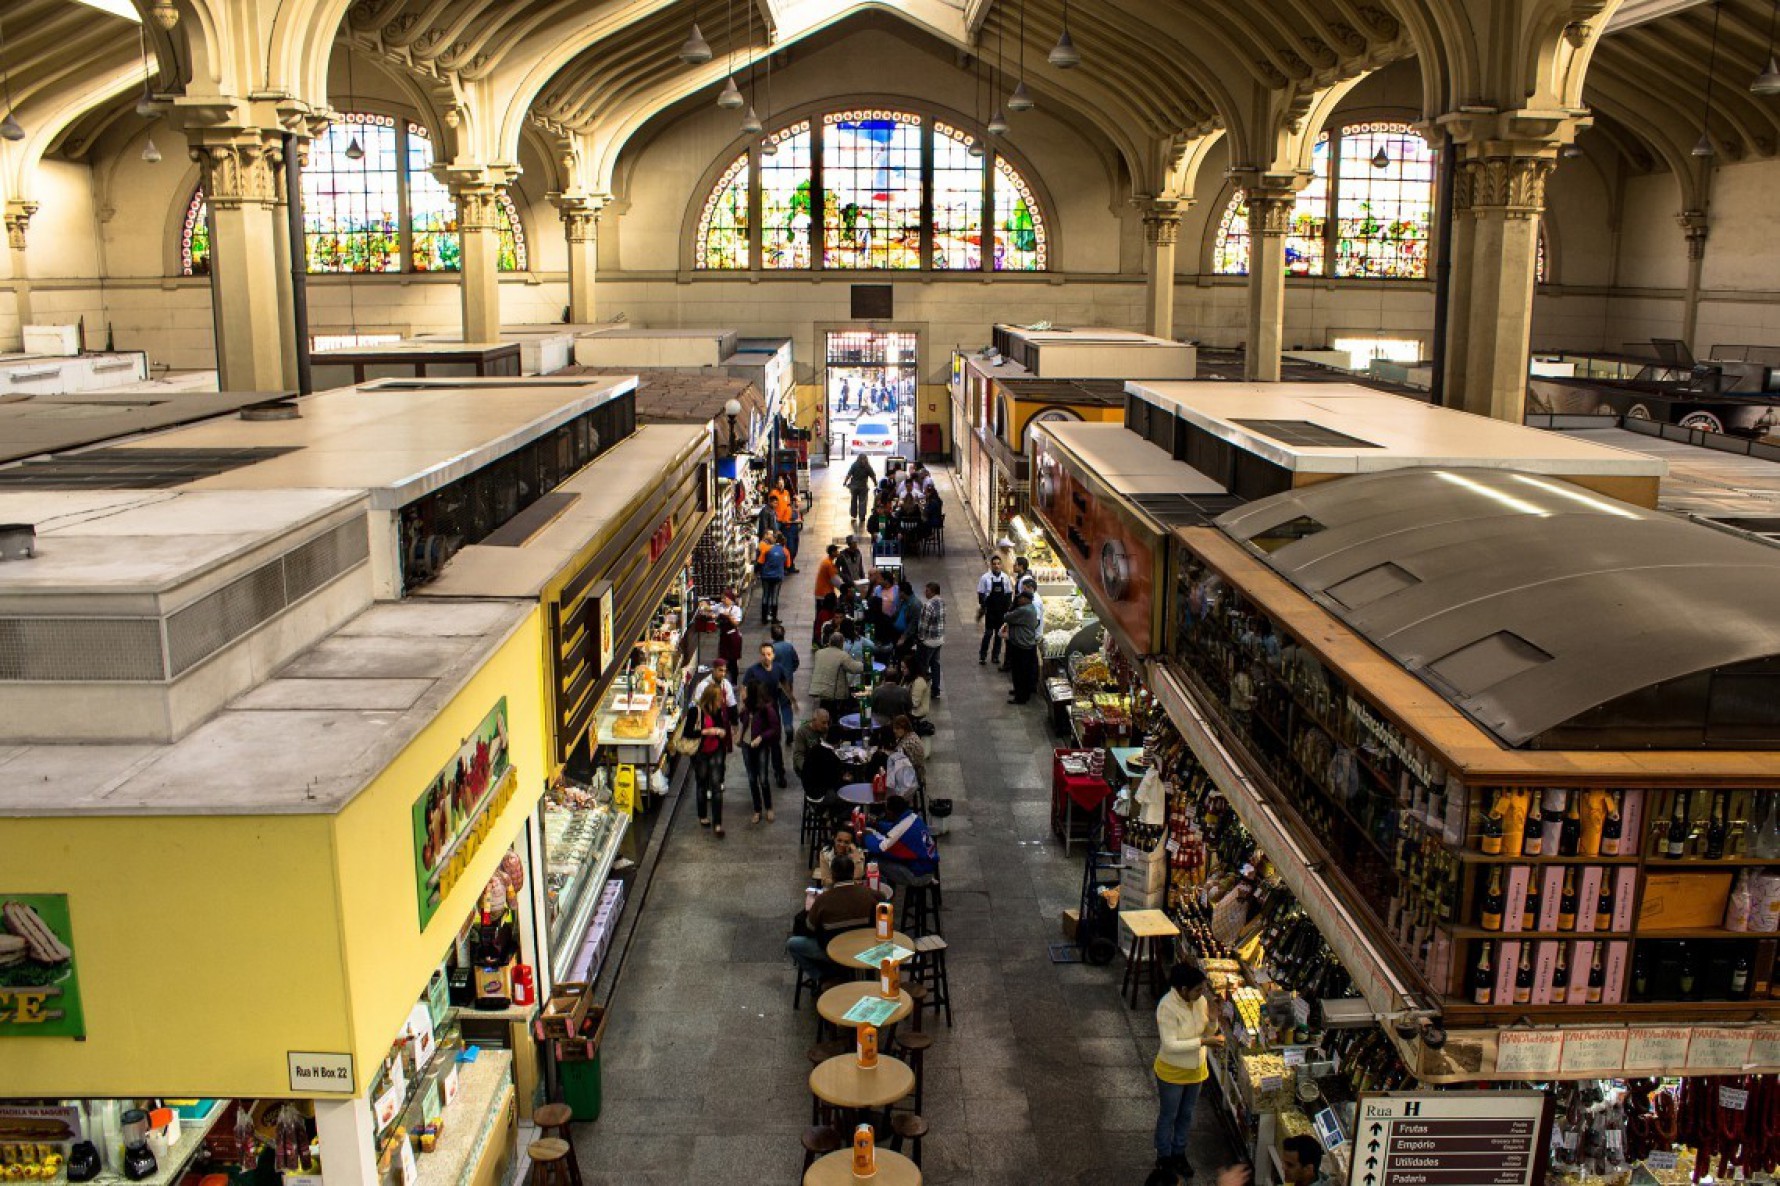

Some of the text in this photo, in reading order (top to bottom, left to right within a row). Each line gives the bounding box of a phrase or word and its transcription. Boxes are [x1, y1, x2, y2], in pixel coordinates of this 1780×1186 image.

[296, 1066, 347, 1079] Rua H Box 22
[1366, 1102, 1421, 1116] Rua H
[1399, 1124, 1428, 1134] Frutas
[1397, 1140, 1436, 1151] Empório
[1395, 1157, 1439, 1167] Utilidades
[1392, 1174, 1427, 1184] Padaria
